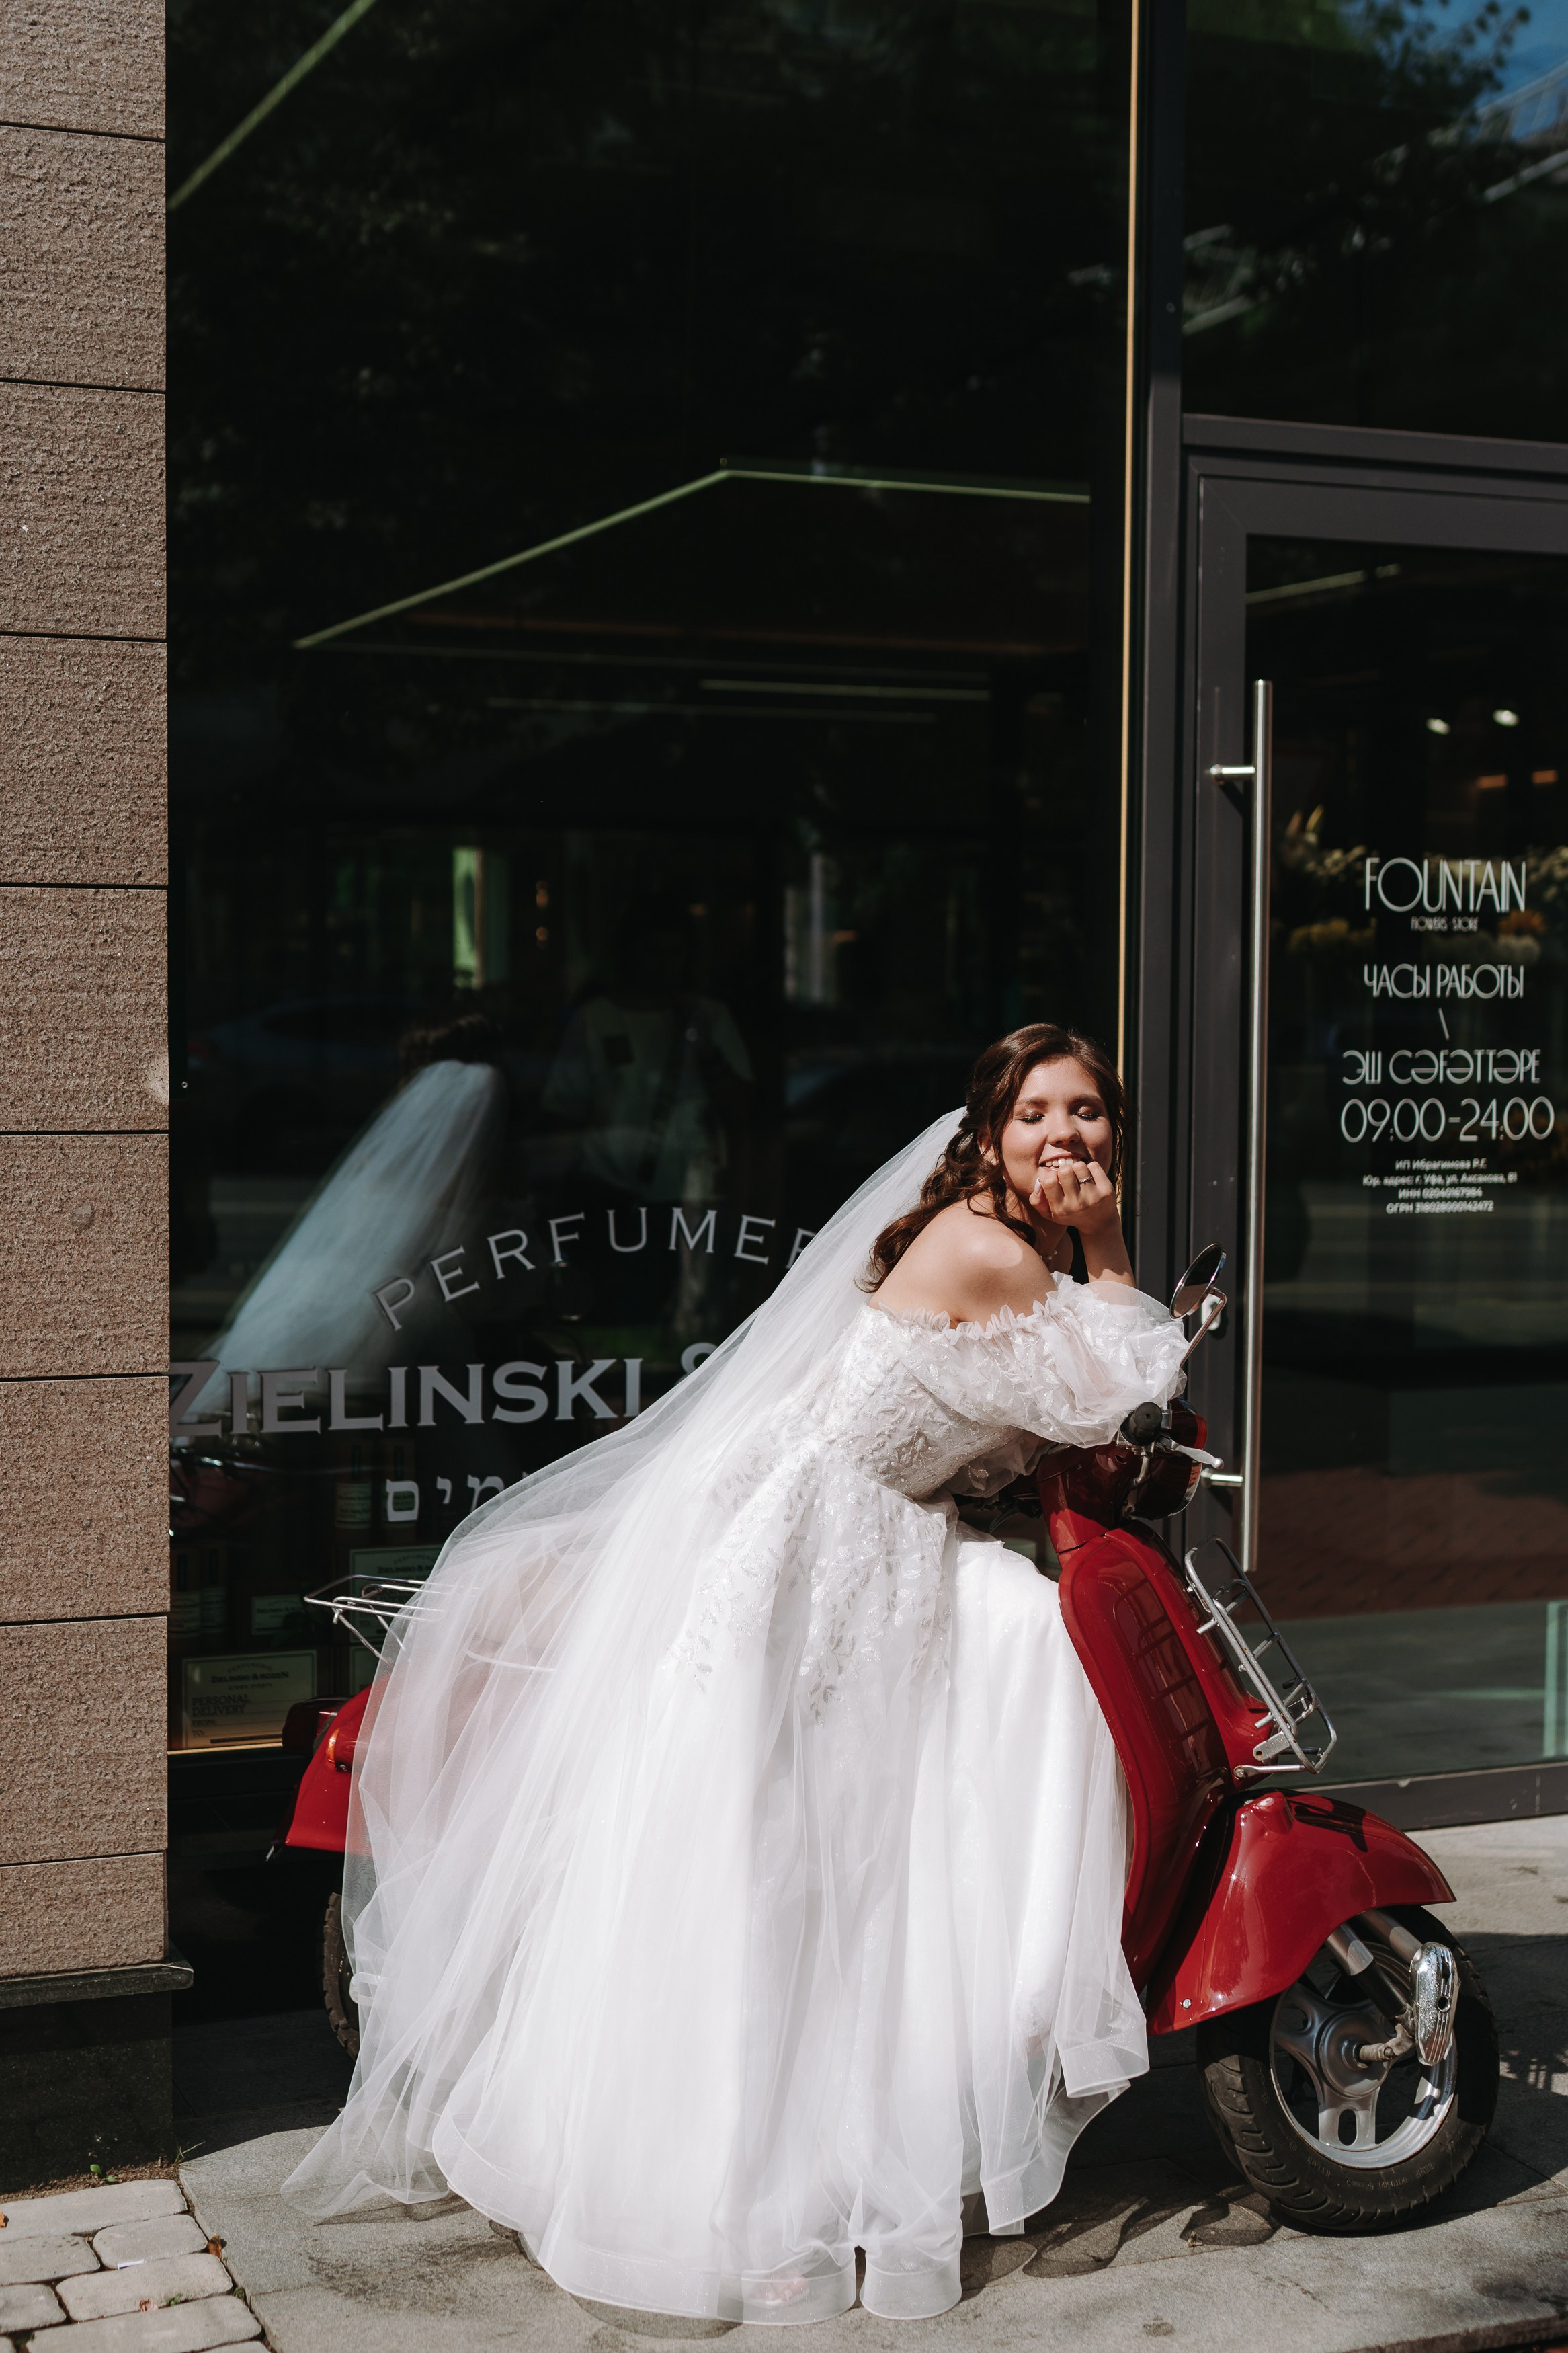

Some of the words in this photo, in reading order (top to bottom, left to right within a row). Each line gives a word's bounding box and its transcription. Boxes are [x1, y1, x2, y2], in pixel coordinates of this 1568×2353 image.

[1365, 857, 1526, 912] FOUNTAIN
[1364, 963, 1430, 998] ЧАСЫ
[1436, 963, 1524, 999] РАБОТЫ
[1342, 1050, 1382, 1085] ЭШ
[1341, 1096, 1555, 1143] 09:00-24:00
[1395, 1159, 1411, 1170] ИП
[1412, 1158, 1471, 1173] Ибрагимова
[1362, 1174, 1382, 1188] Юр.
[1460, 1172, 1507, 1185] Аксакова,
[1398, 1188, 1421, 1199] ИНН
[1385, 1202, 1414, 1215] ОГРН
[169, 1357, 643, 1439] ZIELINSKI
[191, 1693, 252, 1707] PERSONAL
[192, 1704, 246, 1717] DELIVERY
